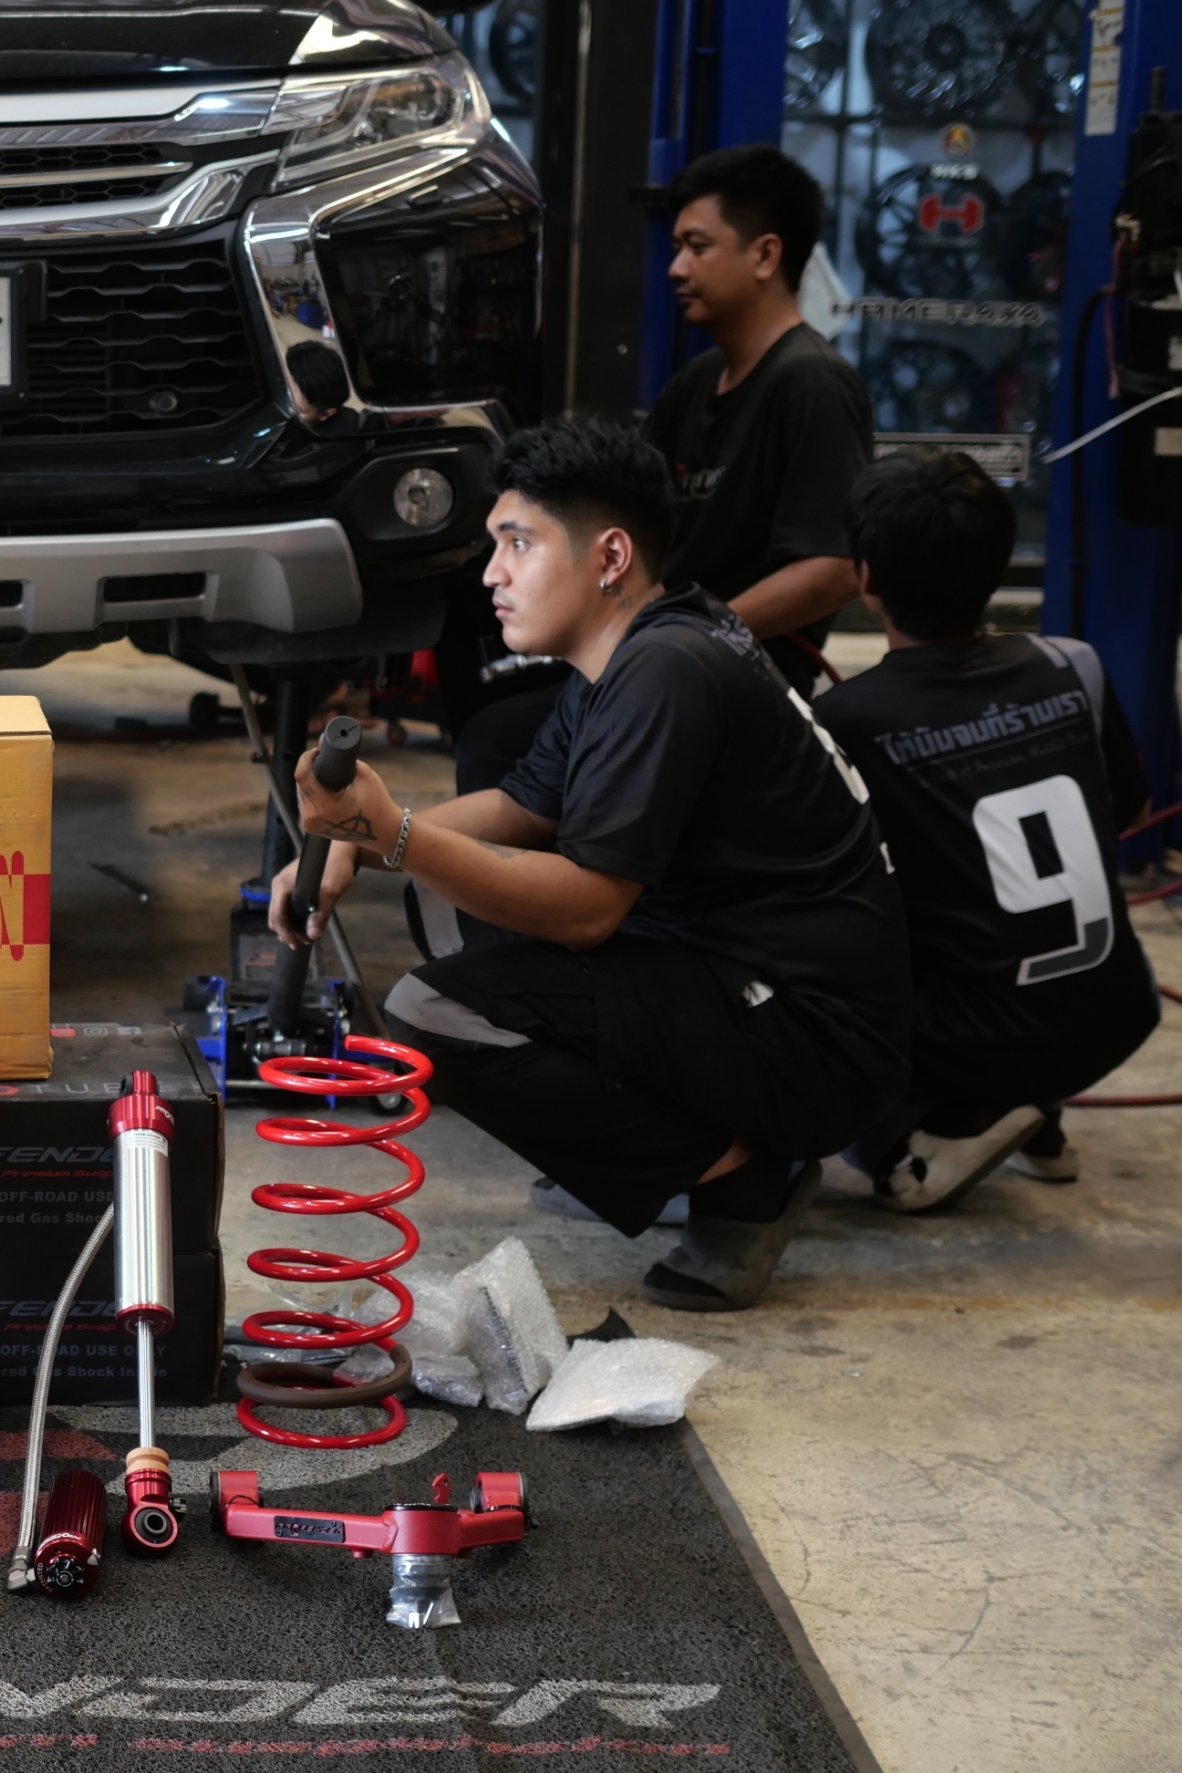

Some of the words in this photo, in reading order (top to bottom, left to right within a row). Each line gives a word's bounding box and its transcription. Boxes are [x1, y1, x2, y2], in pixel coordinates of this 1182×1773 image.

[972, 774, 1115, 986] 9
[1, 1169, 71, 1179] Premium
[30, 1212, 61, 1224] Gas
[85, 1344, 118, 1356] USE
[67, 1365, 115, 1377] Shock
